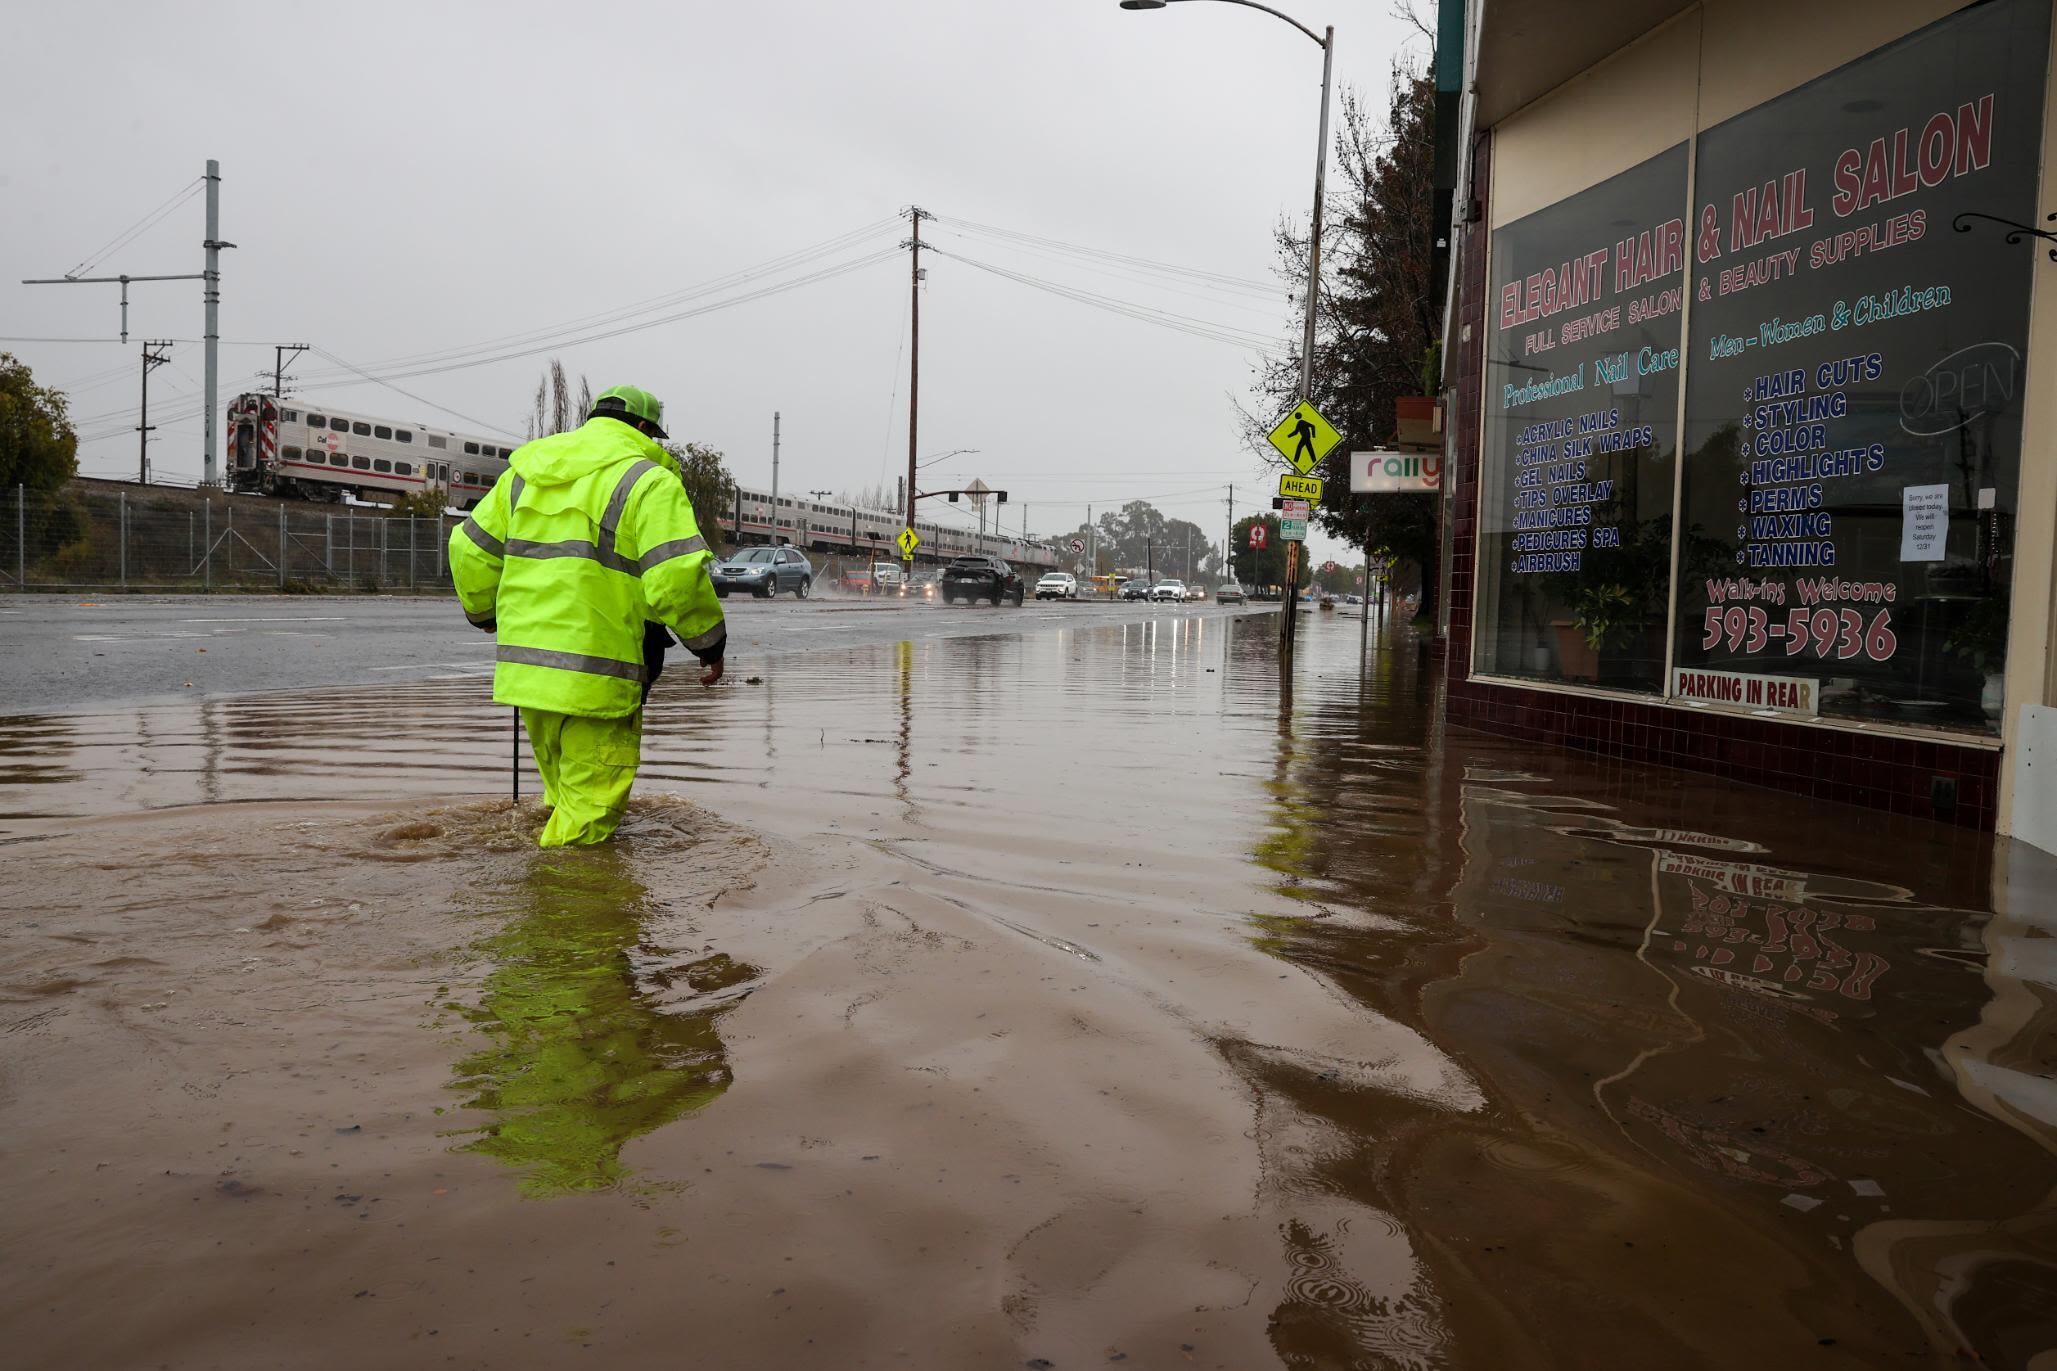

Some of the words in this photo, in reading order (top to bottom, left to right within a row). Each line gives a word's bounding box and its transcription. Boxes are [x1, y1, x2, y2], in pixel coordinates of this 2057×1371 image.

[1500, 248, 1609, 330] ELEGANT
[1615, 218, 1684, 294] HAIR
[1697, 204, 1721, 263] &
[1731, 168, 1814, 252] NAIL
[1833, 93, 1994, 217] SALON
[1525, 329, 1557, 356] FULL
[1561, 306, 1620, 345] SERVICE
[1628, 286, 1682, 324] SALON
[1698, 277, 1711, 301] &
[1719, 247, 1800, 296] BEAUTY
[1810, 209, 1927, 269] SUPPLIES
[1830, 301, 1852, 330] &
[1853, 285, 1952, 326] Children
[1503, 362, 1584, 408] Professional
[1594, 352, 1629, 388] Nail
[1637, 347, 1680, 376] Care
[1755, 369, 1806, 402] HAIR
[1816, 353, 1883, 389] CUTS
[1900, 356, 2015, 419] OPEN
[1522, 418, 1574, 446] ACRYLIC
[1579, 408, 1618, 434] NAILS
[1755, 392, 1847, 430] STYLING
[1522, 444, 1558, 466] CHINA
[1563, 436, 1593, 460] SILK
[1600, 425, 1653, 454] WRAPS
[1755, 424, 1825, 456] COLOR
[1367, 457, 1441, 487] rally
[1520, 467, 1542, 488] GEL
[1548, 461, 1585, 484] NAILS
[1751, 444, 1884, 485] HIGHLIGHTS
[1284, 480, 1318, 494] AHEAD
[1520, 489, 1546, 509] TIPS
[1553, 480, 1613, 505] OVERLAY
[1751, 483, 1822, 513] PERMS
[1518, 505, 1592, 529] MANICURES
[1750, 512, 1831, 539] WAXING
[1517, 528, 1587, 552] PEDICURES
[1593, 527, 1620, 548] SPA
[1748, 541, 1835, 567] TANNING
[1516, 551, 1581, 573] AIRBRUSH
[1706, 576, 1785, 605] Walk-ins
[1796, 575, 1896, 605] Welcome
[1702, 606, 1897, 661] 593-5936
[1679, 672, 1742, 702] PARKING
[1746, 679, 1763, 706] IN
[1767, 681, 1811, 710] REAR
